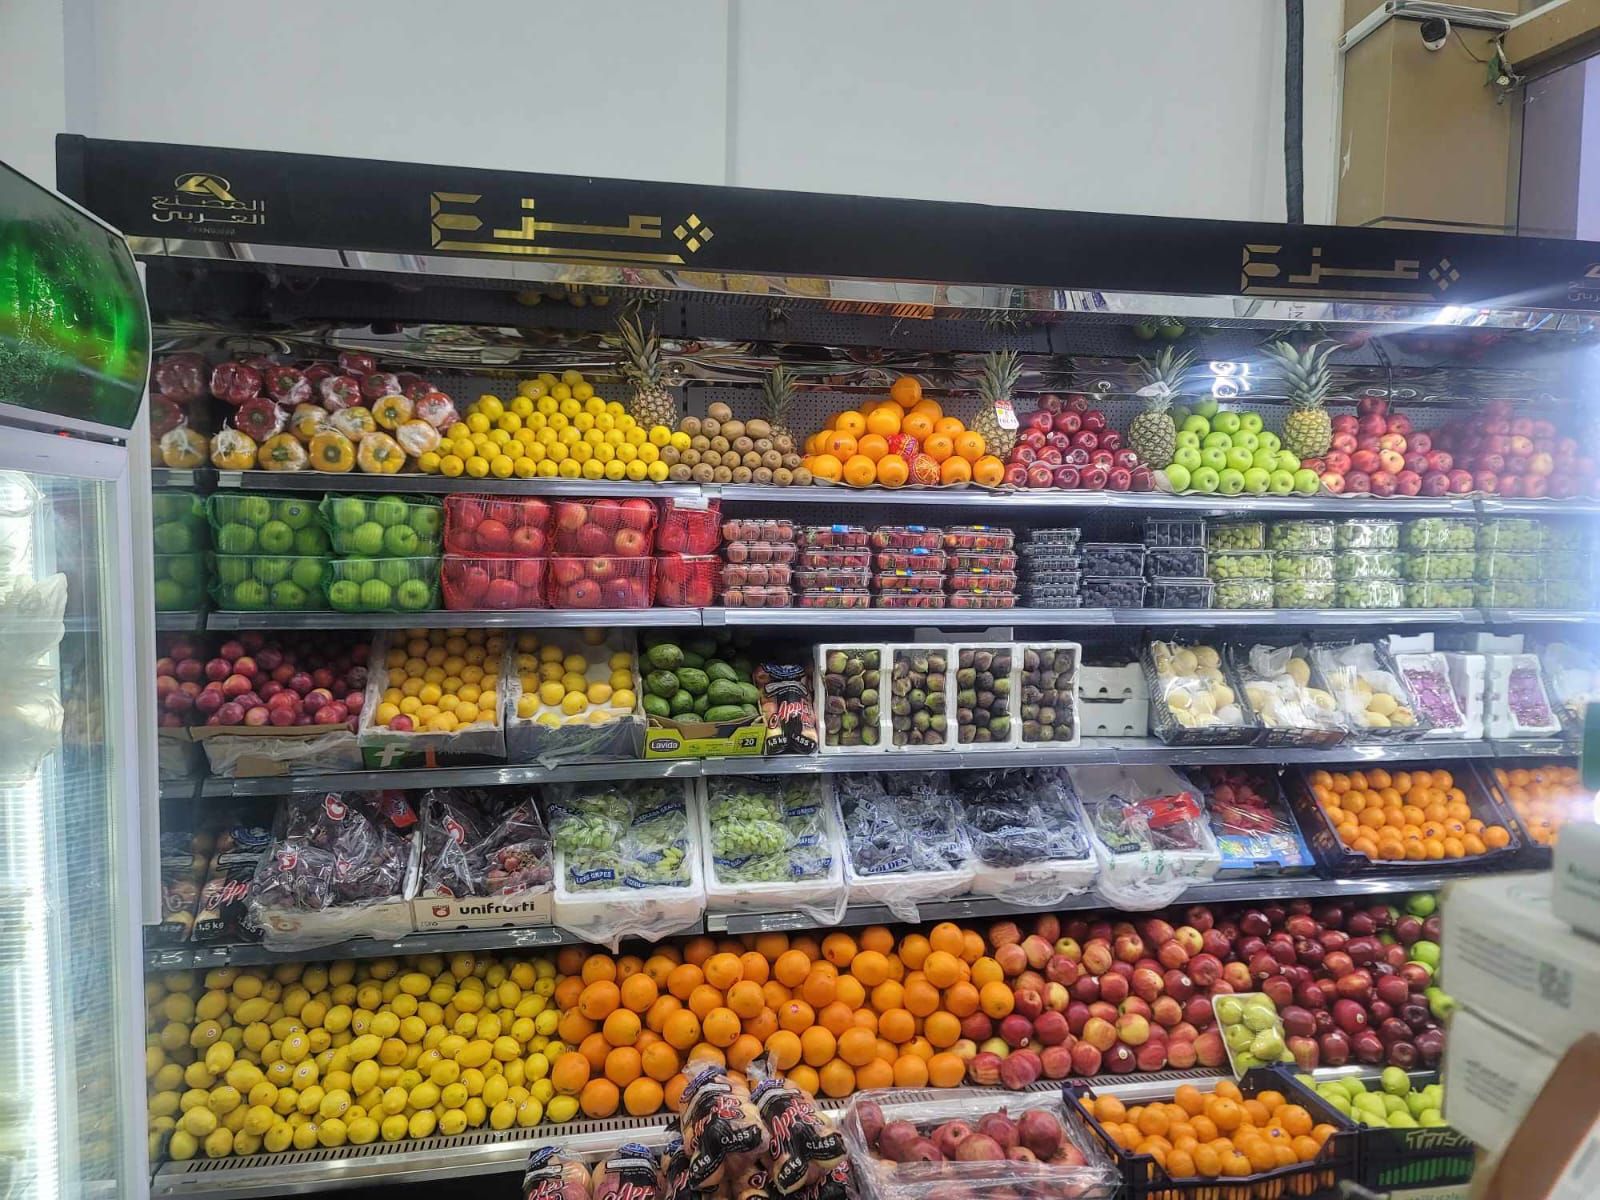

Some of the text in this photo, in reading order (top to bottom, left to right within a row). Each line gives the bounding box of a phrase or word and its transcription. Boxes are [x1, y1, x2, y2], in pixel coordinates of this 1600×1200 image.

[651, 741, 678, 749] Lavida
[744, 738, 754, 746] 20
[805, 1136, 837, 1150] CLASS
[697, 1154, 711, 1168] kg
[789, 1157, 803, 1170] kg
